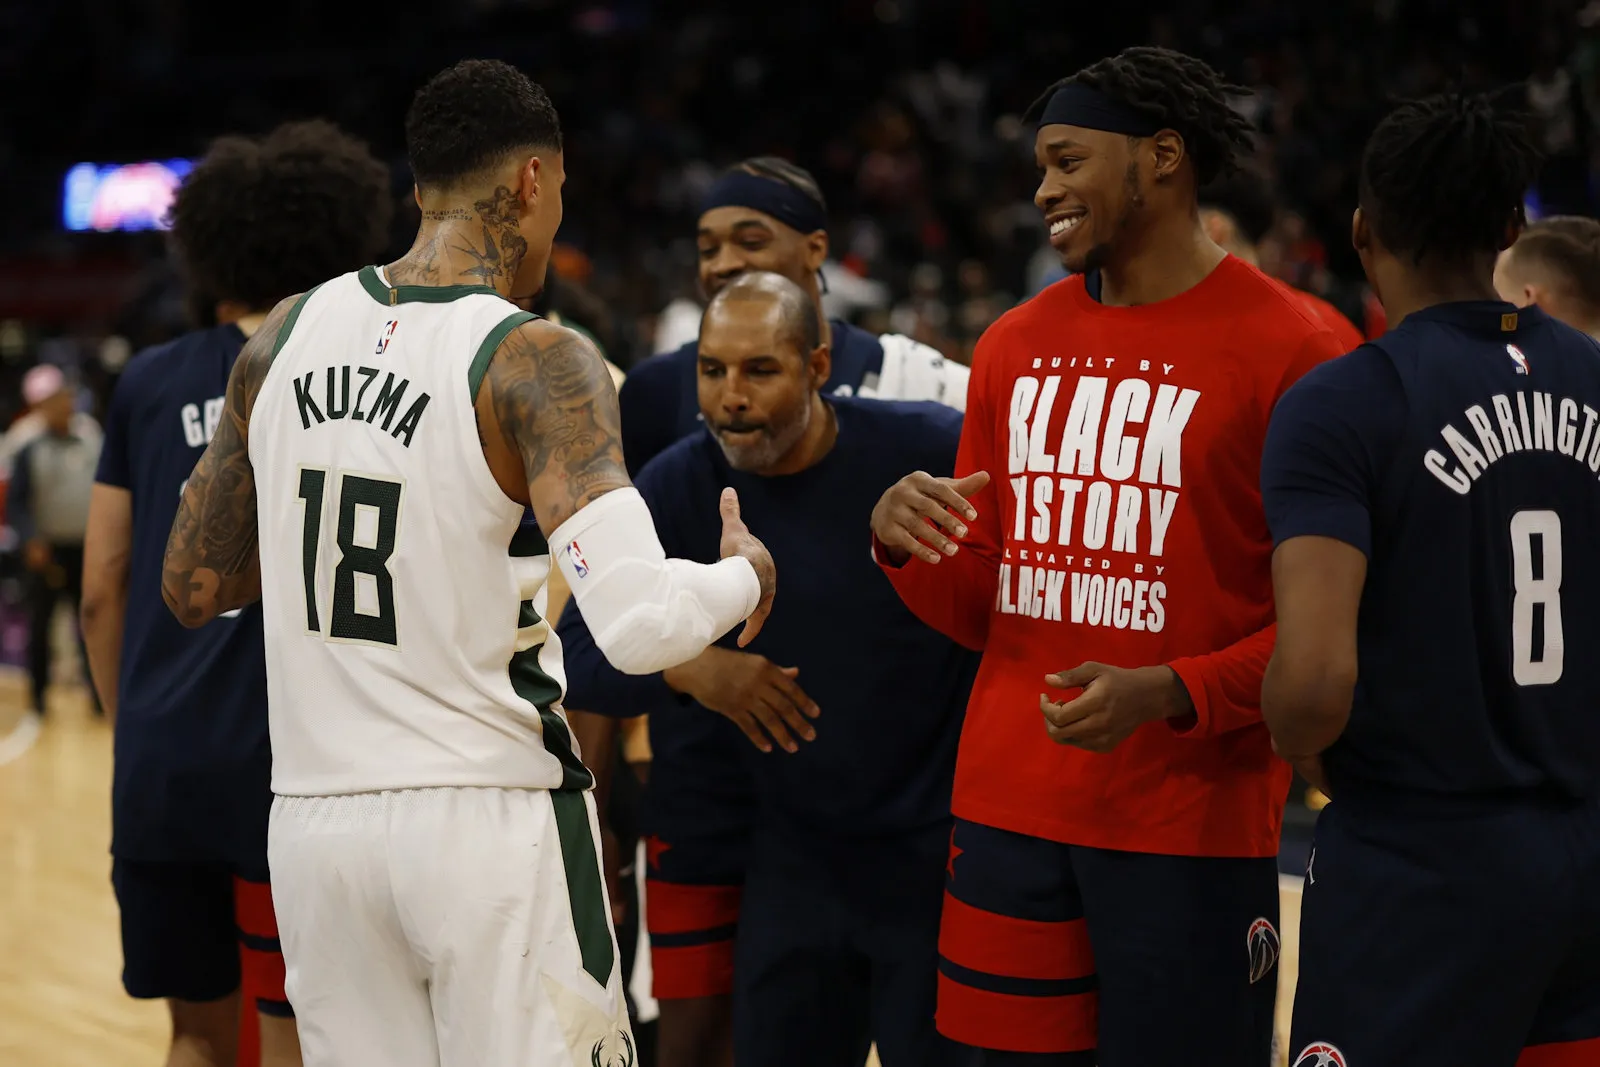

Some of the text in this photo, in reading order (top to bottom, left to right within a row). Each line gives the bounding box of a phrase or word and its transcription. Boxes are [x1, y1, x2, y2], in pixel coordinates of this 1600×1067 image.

[293, 365, 431, 448] KUZMA
[1032, 356, 1175, 376] BUILT BY
[1008, 375, 1201, 488] BLACK
[1424, 390, 1600, 496] CARRINGTO
[1009, 475, 1180, 557] ISTORY
[295, 464, 407, 653] 18
[996, 562, 1168, 634] LACK VOICES
[1004, 548, 1166, 577] LEVATED BY
[1509, 509, 1565, 687] 8
